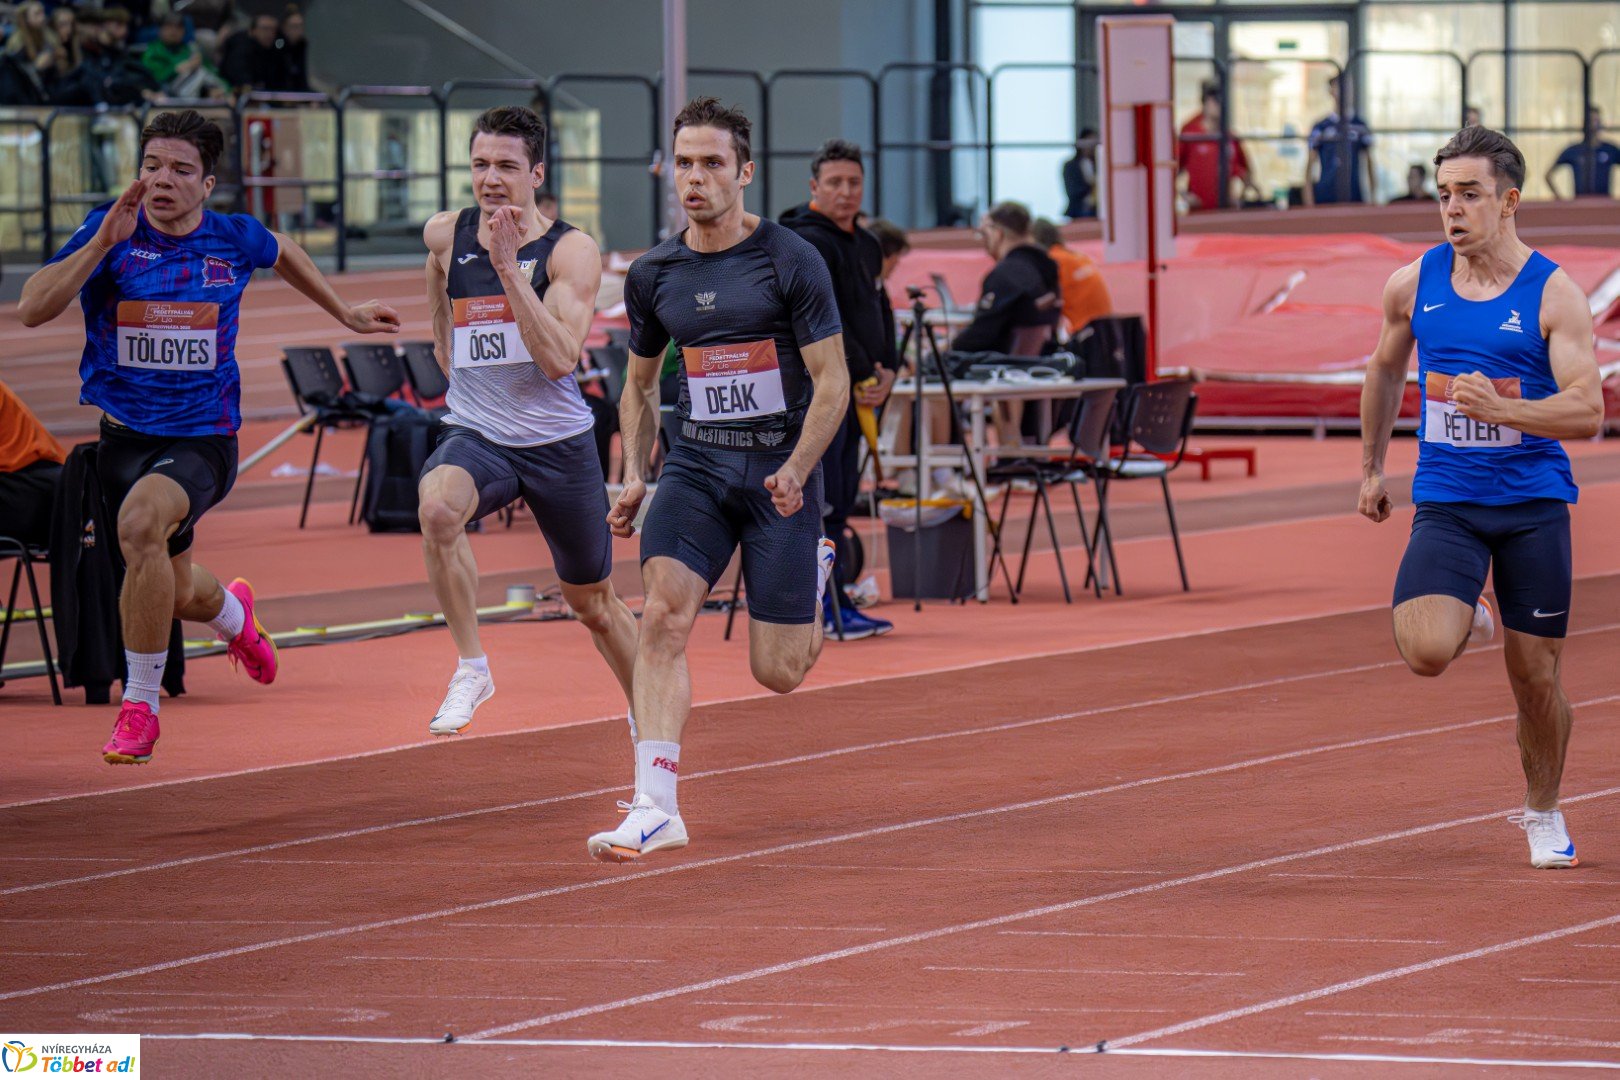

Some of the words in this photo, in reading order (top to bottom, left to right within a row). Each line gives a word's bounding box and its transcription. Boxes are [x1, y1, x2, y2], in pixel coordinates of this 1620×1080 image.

[125, 332, 210, 365] TÖLGYES
[469, 329, 507, 361] ŐCSI
[705, 379, 759, 414] DEÁK
[697, 427, 754, 447] AESTHETICS
[1444, 410, 1501, 441] PÉTER
